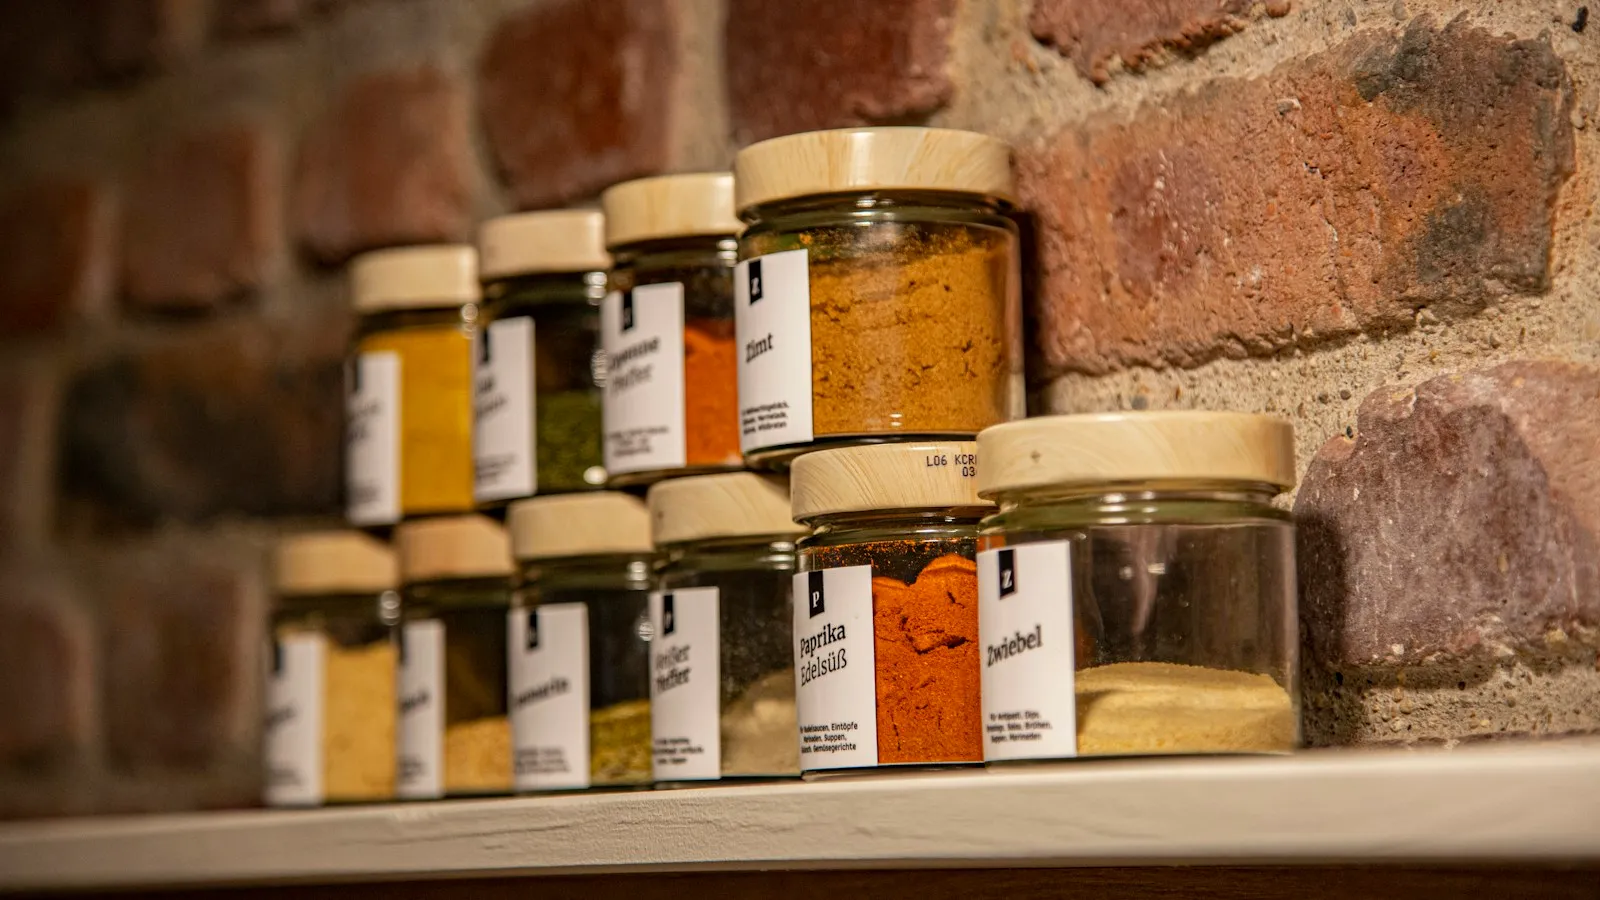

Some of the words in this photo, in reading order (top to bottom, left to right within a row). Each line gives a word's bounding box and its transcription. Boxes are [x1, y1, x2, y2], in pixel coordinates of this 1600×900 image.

[745, 332, 773, 364] Zimt
[926, 455, 948, 467] L06
[962, 466, 976, 477] 03
[1001, 568, 1013, 589] Z
[812, 591, 821, 609] P
[800, 622, 847, 659] Paprika
[987, 623, 1043, 668] Zwiebel
[801, 648, 848, 688] Edelsüß
[831, 721, 858, 732] Eintöpfe
[824, 733, 847, 743] Suppen,
[813, 742, 857, 754] Gemüsegerichte
